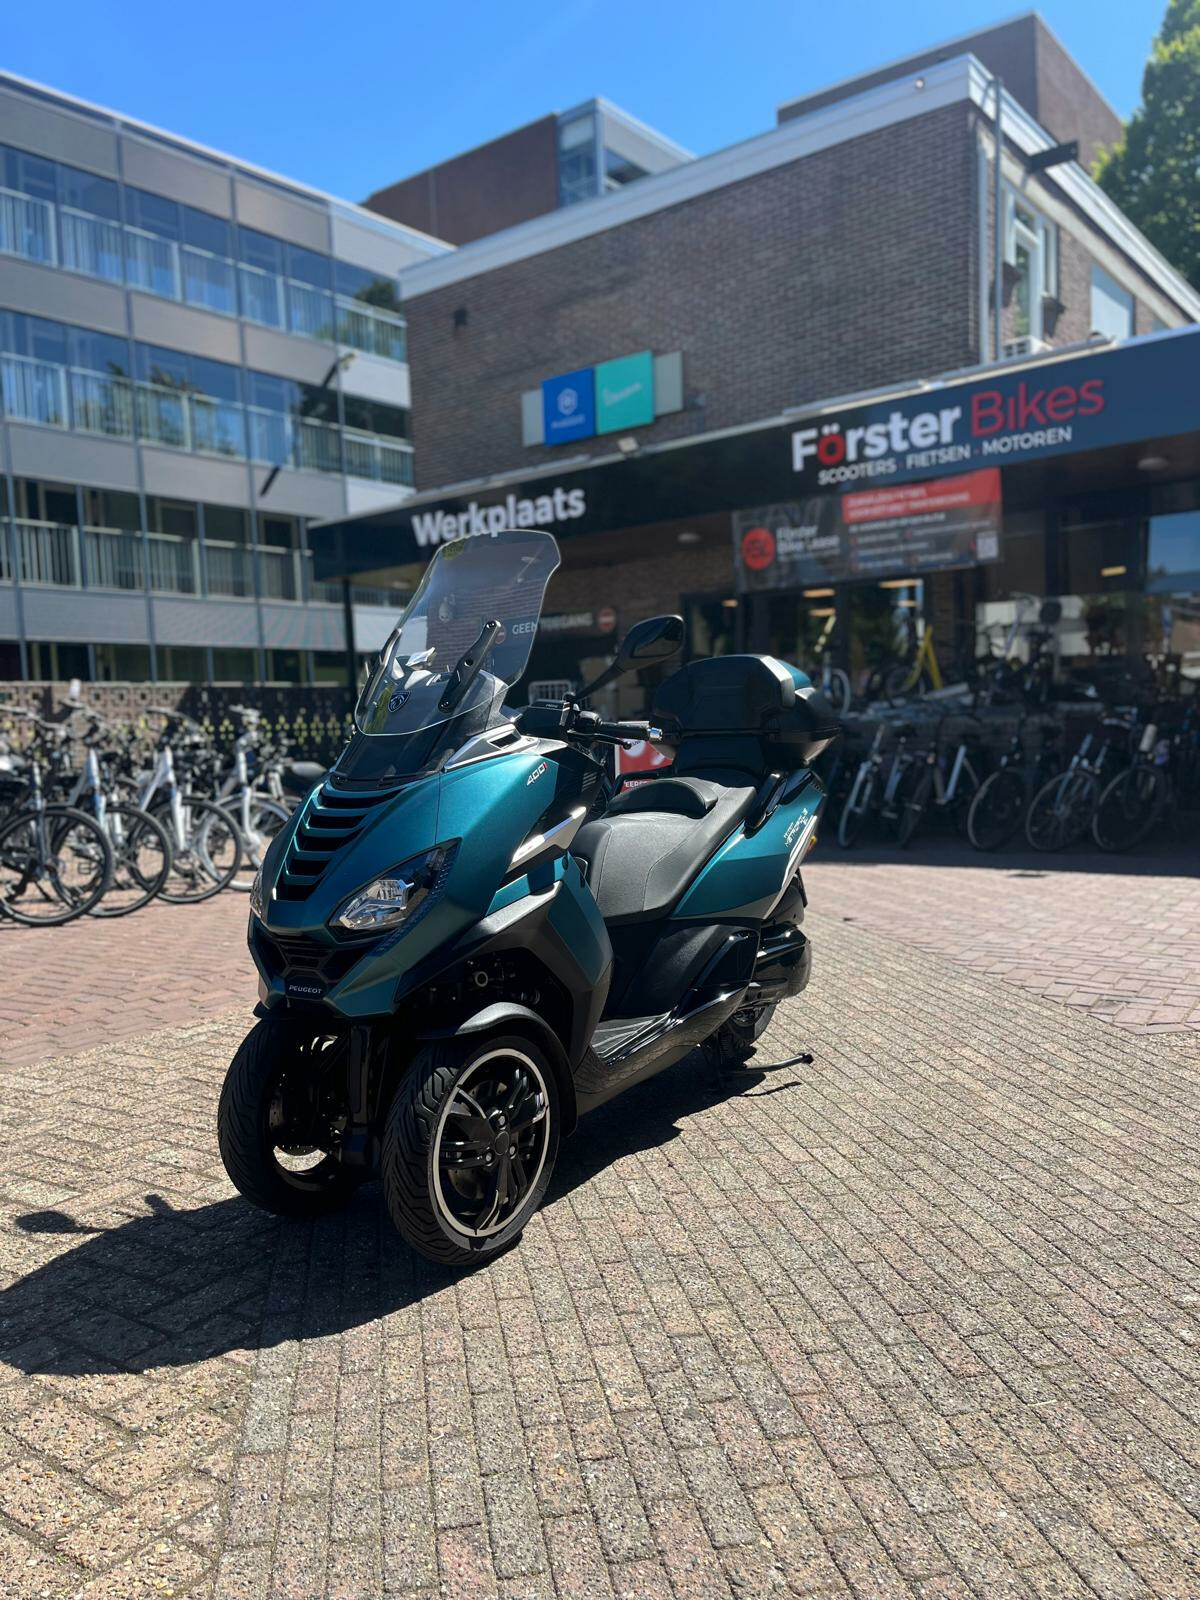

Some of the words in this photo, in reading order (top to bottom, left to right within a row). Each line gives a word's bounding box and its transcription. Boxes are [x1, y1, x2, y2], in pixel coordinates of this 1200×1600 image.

[791, 405, 962, 472] Förster
[971, 379, 1105, 437] Bikes
[817, 457, 897, 485] SCOOTERS
[906, 443, 971, 470] FIETSEN
[982, 426, 1073, 456] MOTOREN
[411, 487, 586, 547] Werkplaats
[288, 984, 322, 994] PEUGEOT
